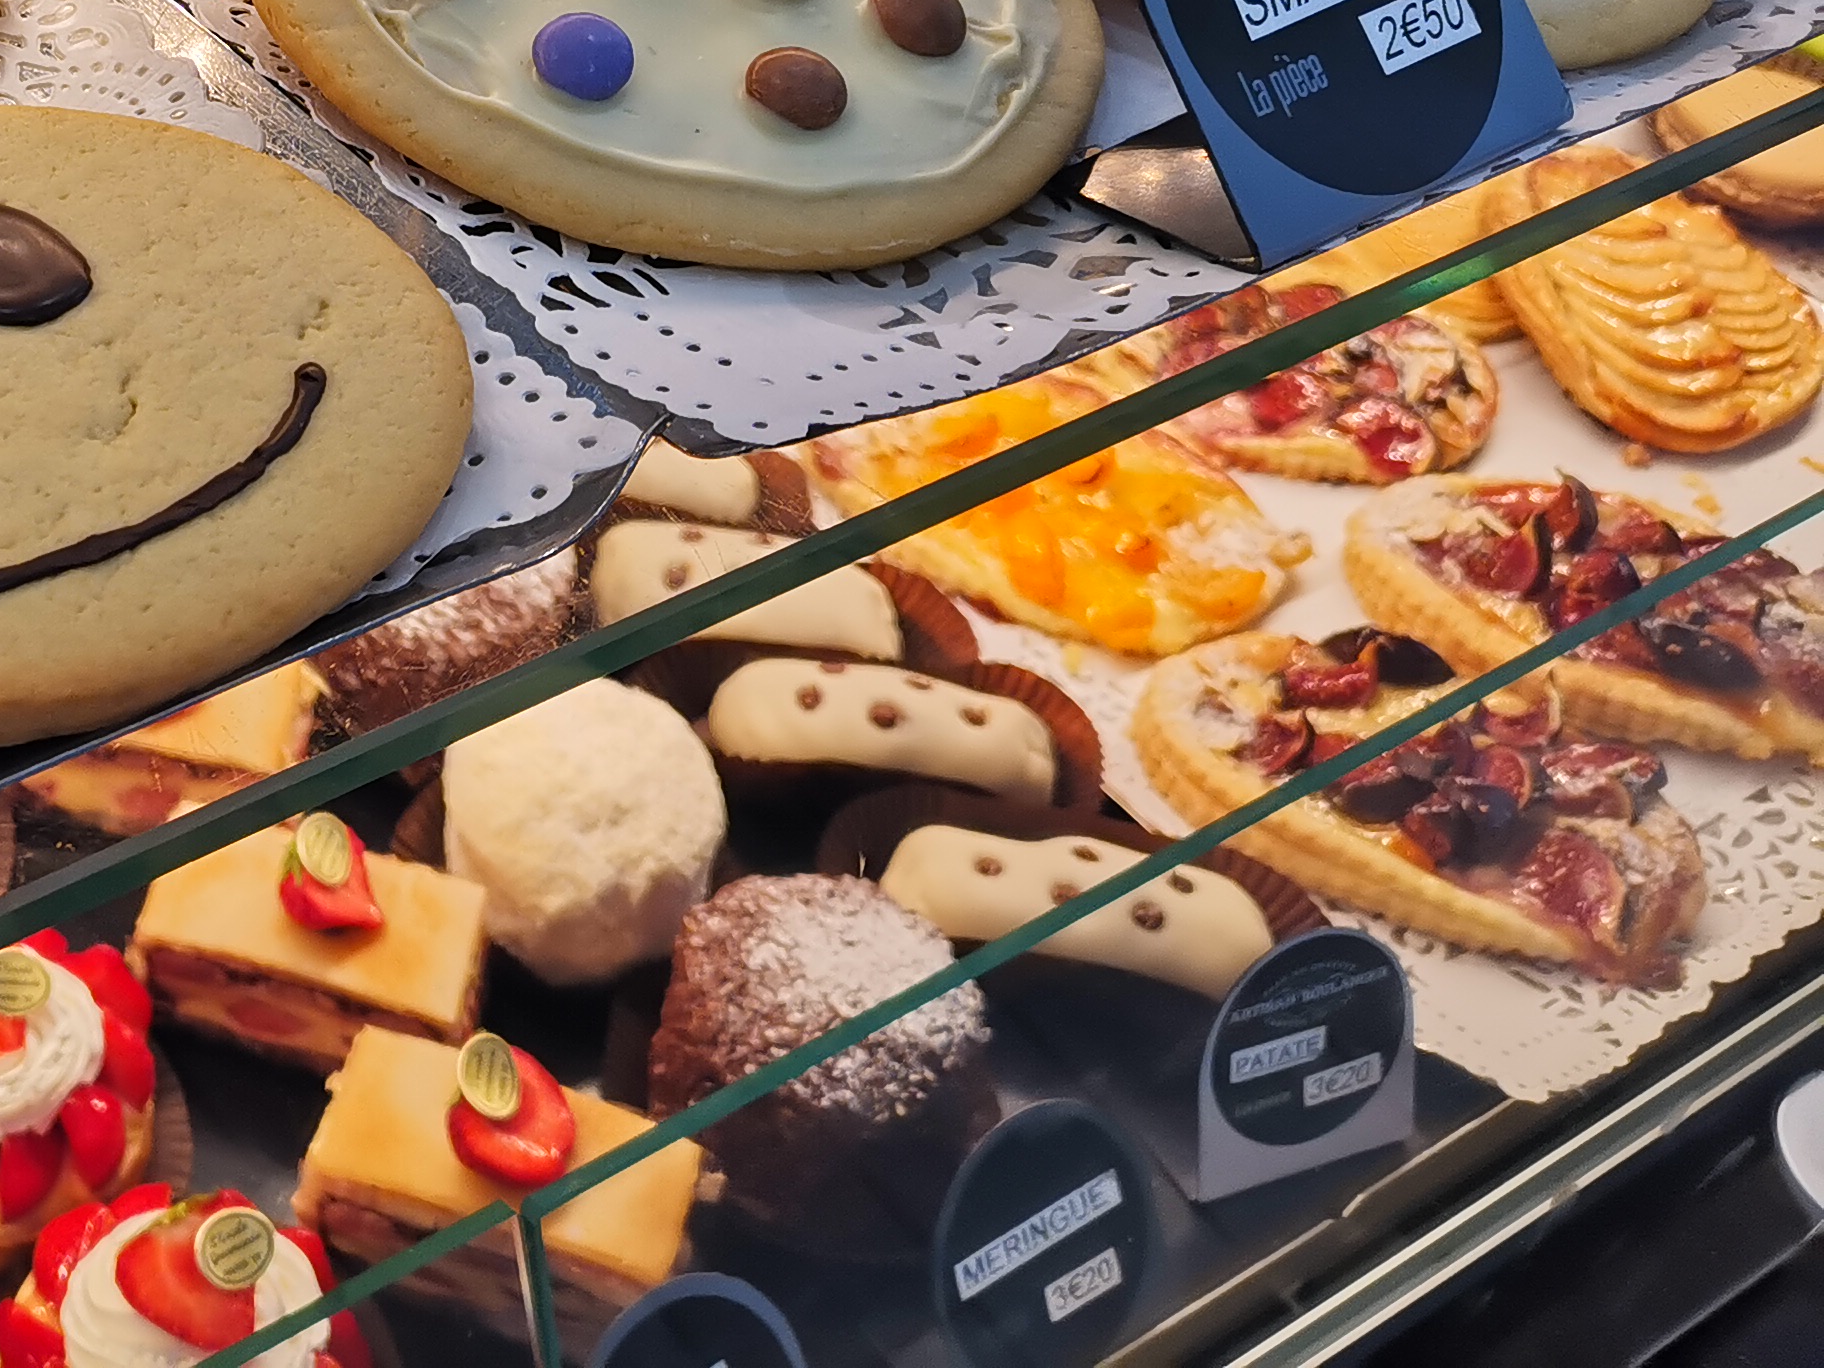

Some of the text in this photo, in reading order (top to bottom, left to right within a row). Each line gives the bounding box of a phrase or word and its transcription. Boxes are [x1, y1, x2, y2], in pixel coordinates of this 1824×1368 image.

[1236, 52, 1329, 119] La pièce
[1234, 1034, 1322, 1076] PATATE
[960, 1181, 1111, 1288] MERINGUE
[1049, 1254, 1114, 1312] 3€20
